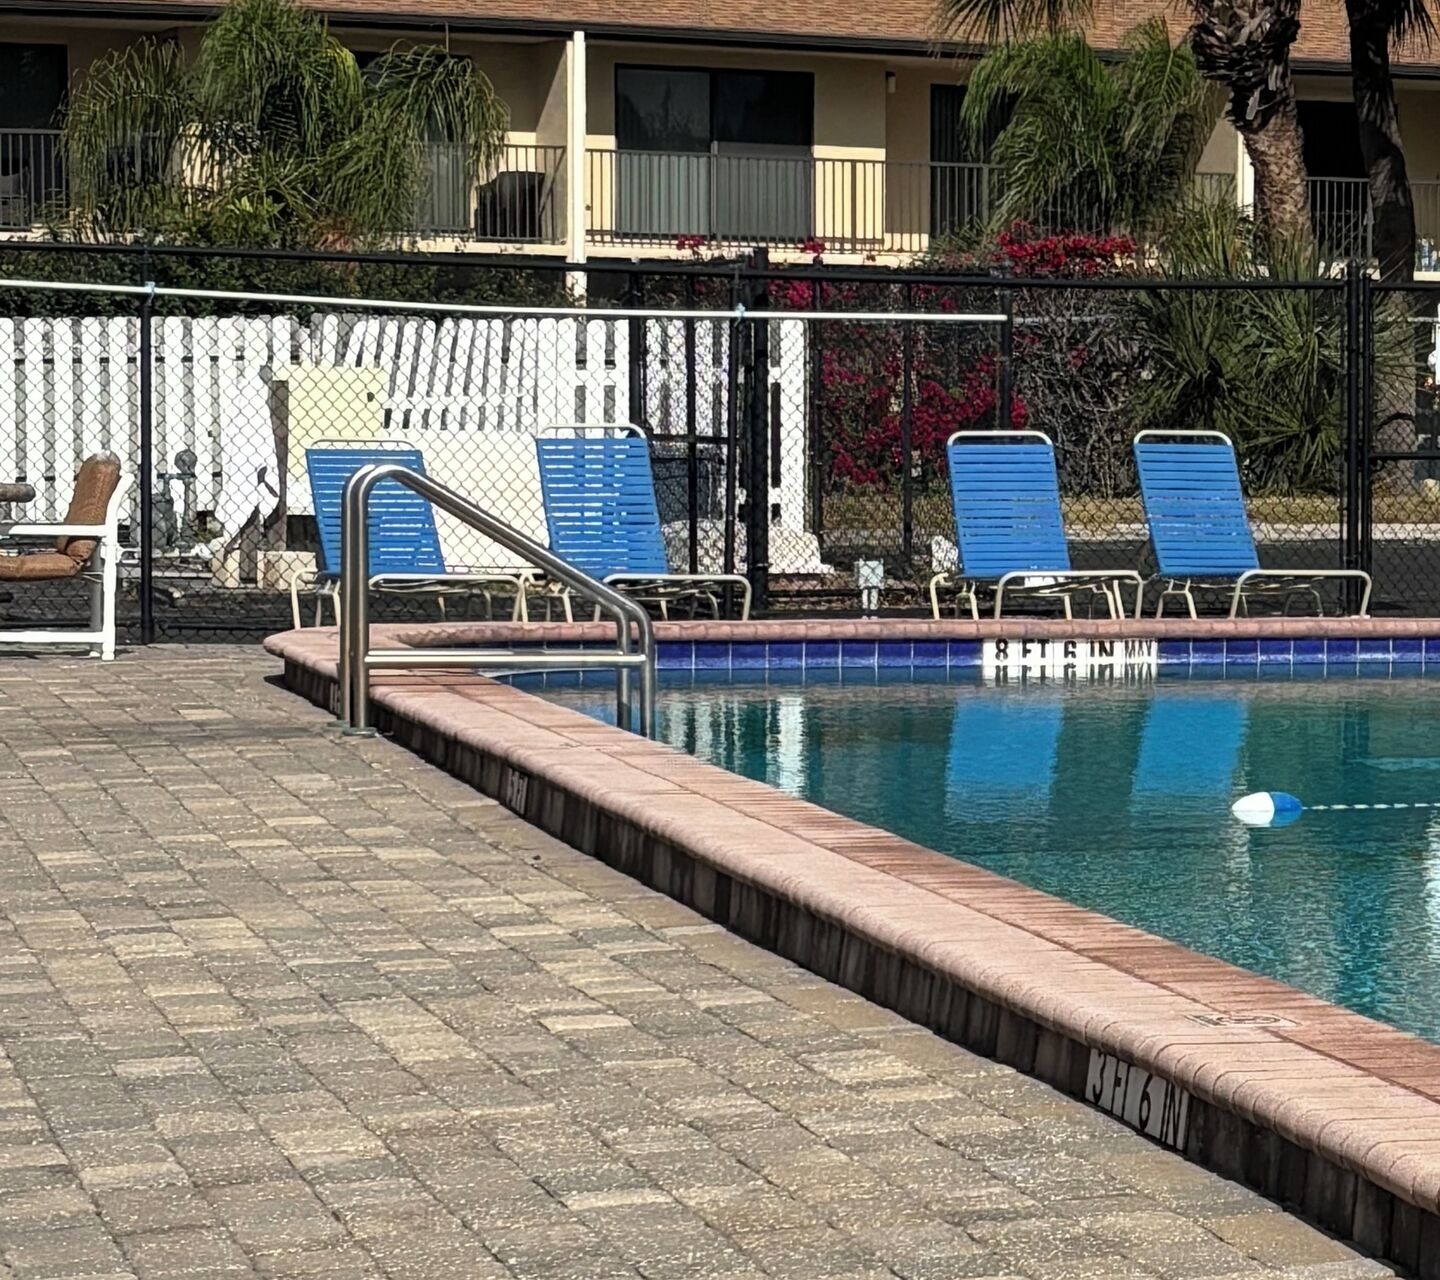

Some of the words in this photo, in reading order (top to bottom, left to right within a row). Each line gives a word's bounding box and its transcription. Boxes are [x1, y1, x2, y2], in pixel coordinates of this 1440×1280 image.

[995, 638, 1009, 661] 8
[1021, 638, 1050, 659] FT
[1089, 639, 1115, 658] IN
[1139, 1071, 1153, 1132] 6
[1160, 1079, 1185, 1148] IN
